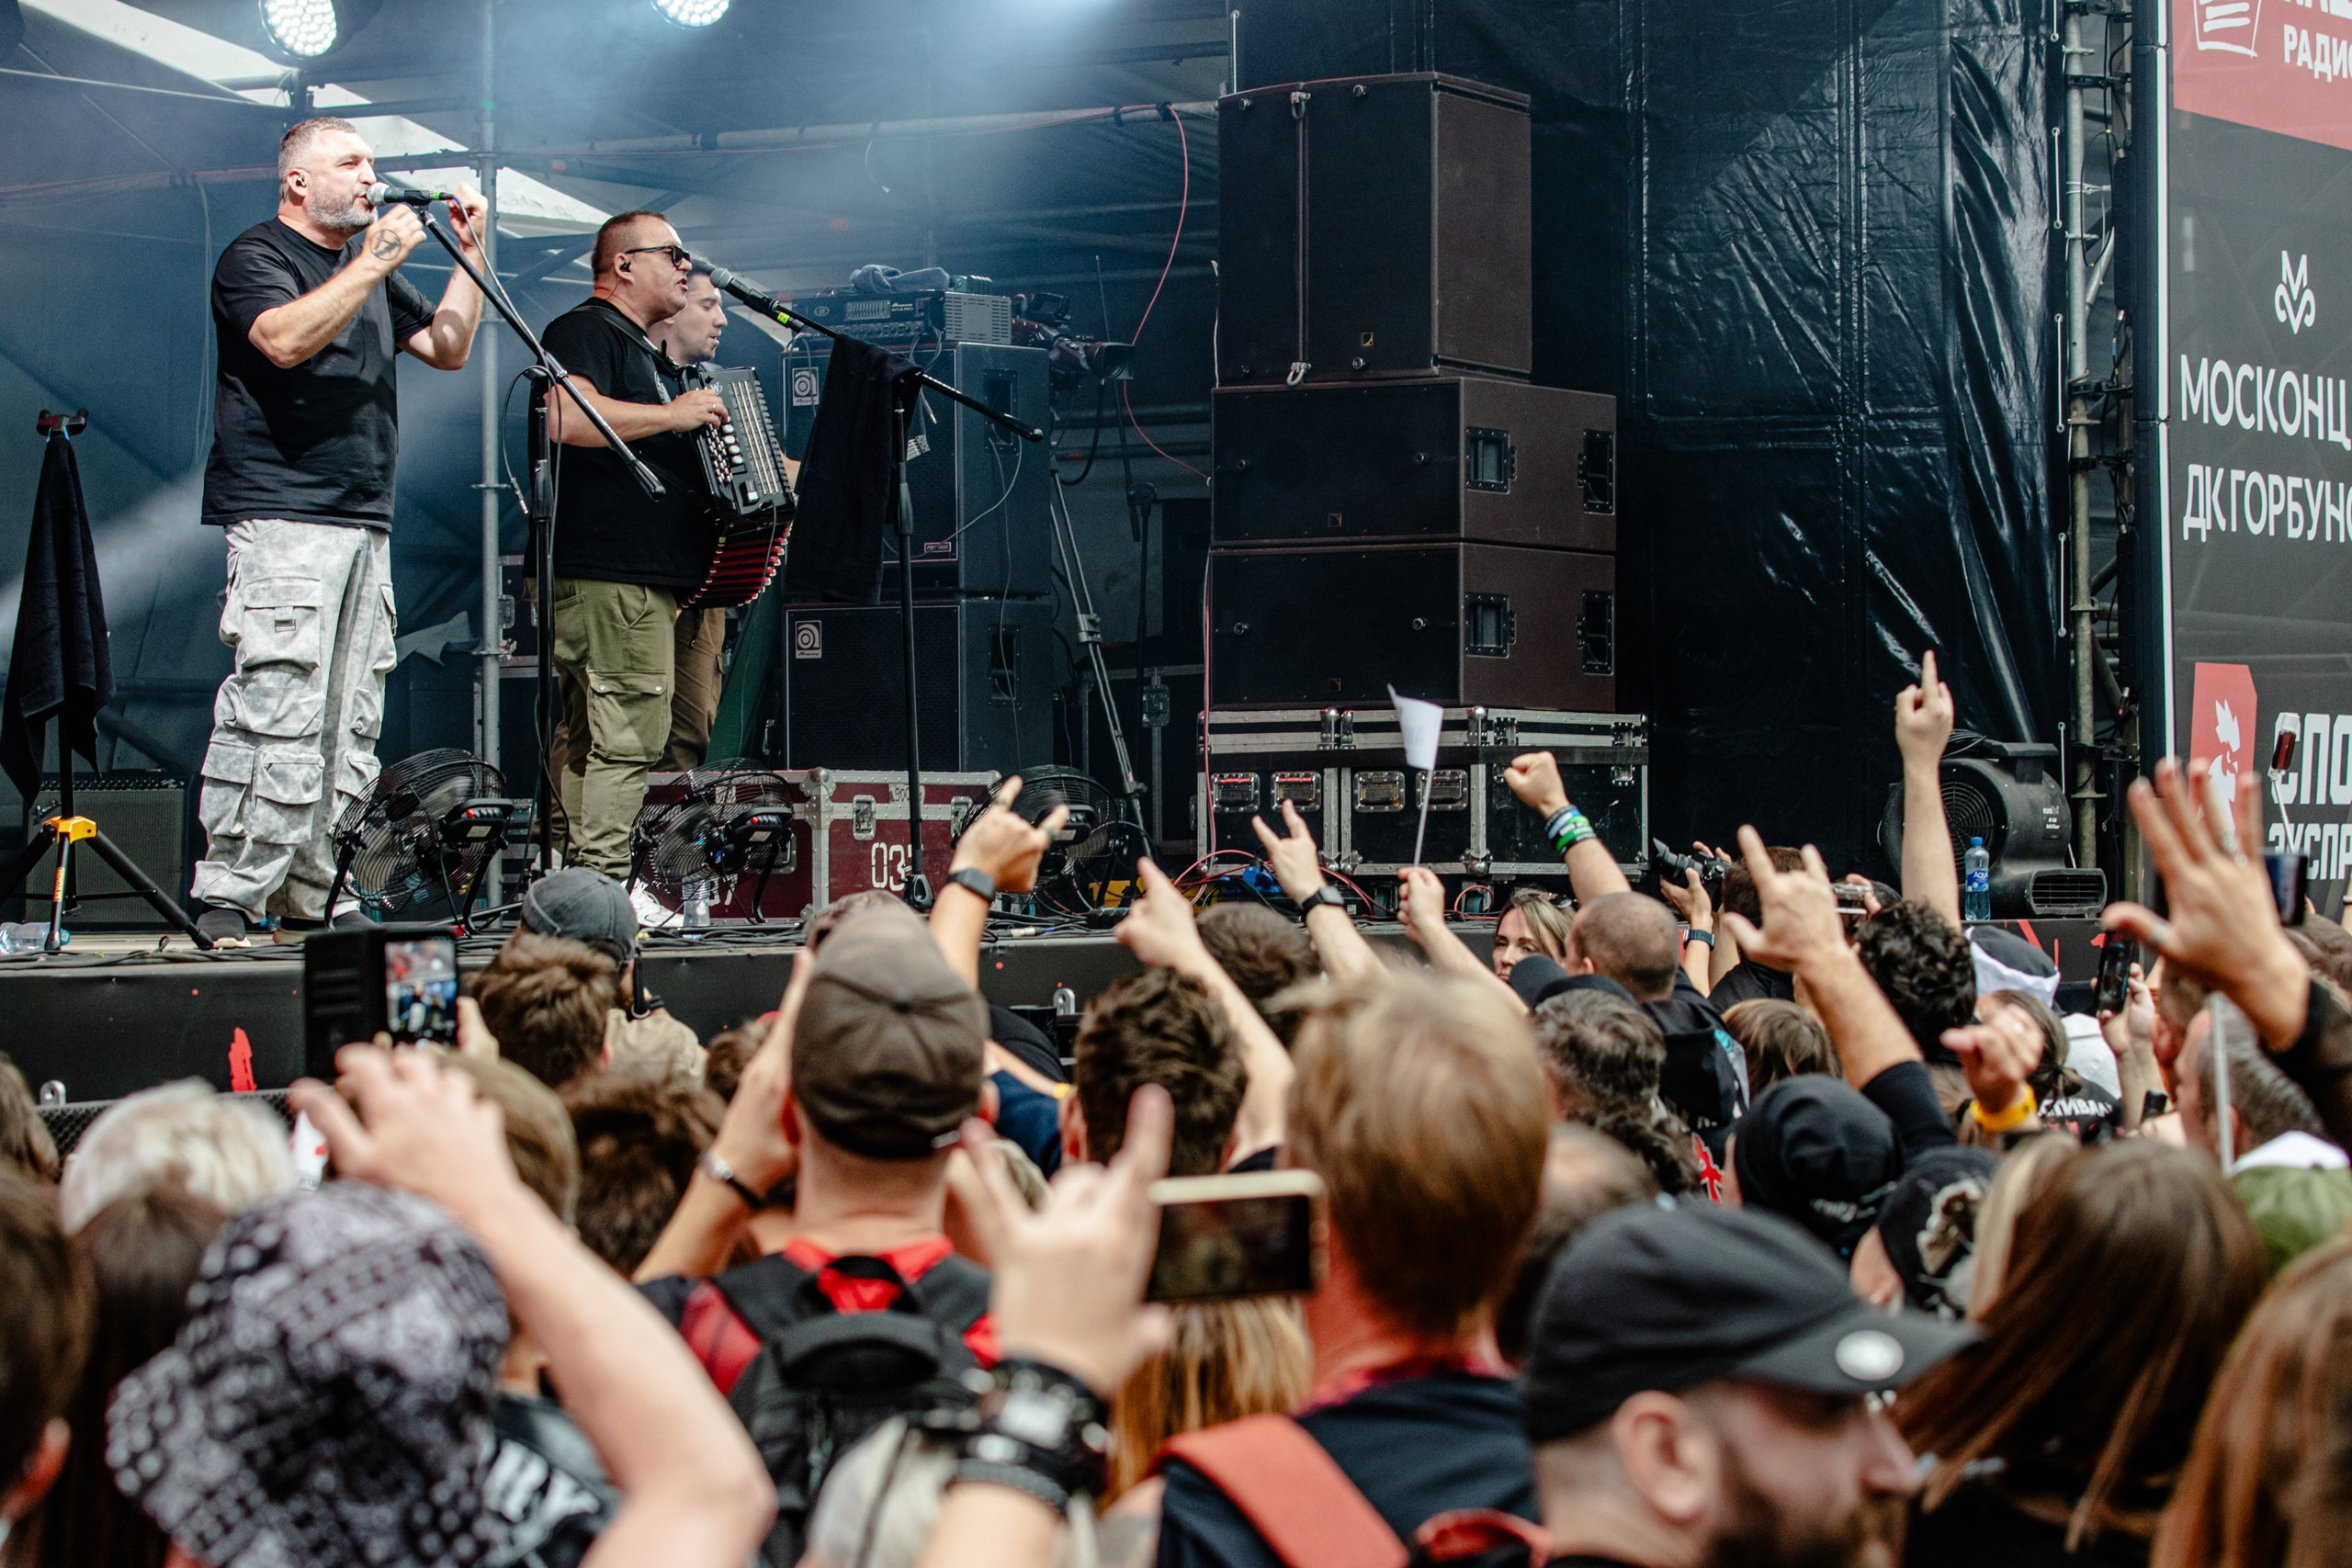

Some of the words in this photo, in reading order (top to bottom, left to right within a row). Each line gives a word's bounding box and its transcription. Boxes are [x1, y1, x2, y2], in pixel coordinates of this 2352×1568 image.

[2283, 23, 2352, 83] РАДИ
[2181, 354, 2352, 451] МОСКОНЦ
[2183, 463, 2226, 543] ДК
